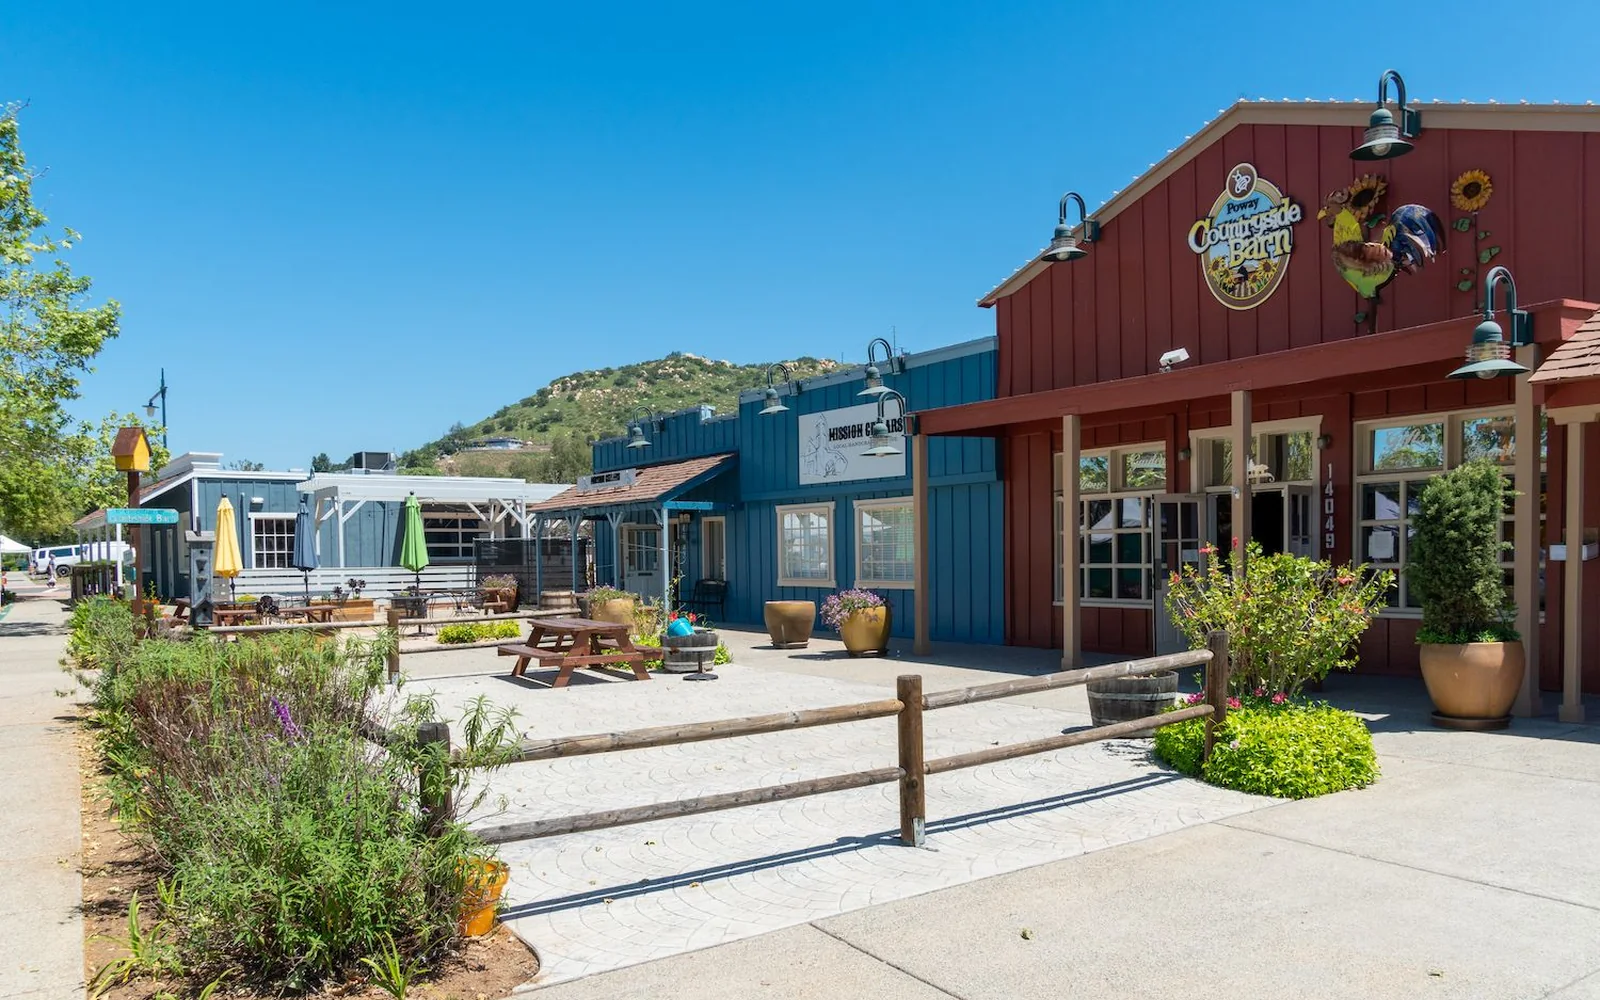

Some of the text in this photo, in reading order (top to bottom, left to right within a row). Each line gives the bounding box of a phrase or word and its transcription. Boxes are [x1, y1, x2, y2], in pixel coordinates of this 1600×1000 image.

[1226, 198, 1259, 214] Poway
[1188, 197, 1302, 254] Countryside
[1229, 227, 1293, 268] Barn
[828, 417, 903, 441] MISSION CEARS
